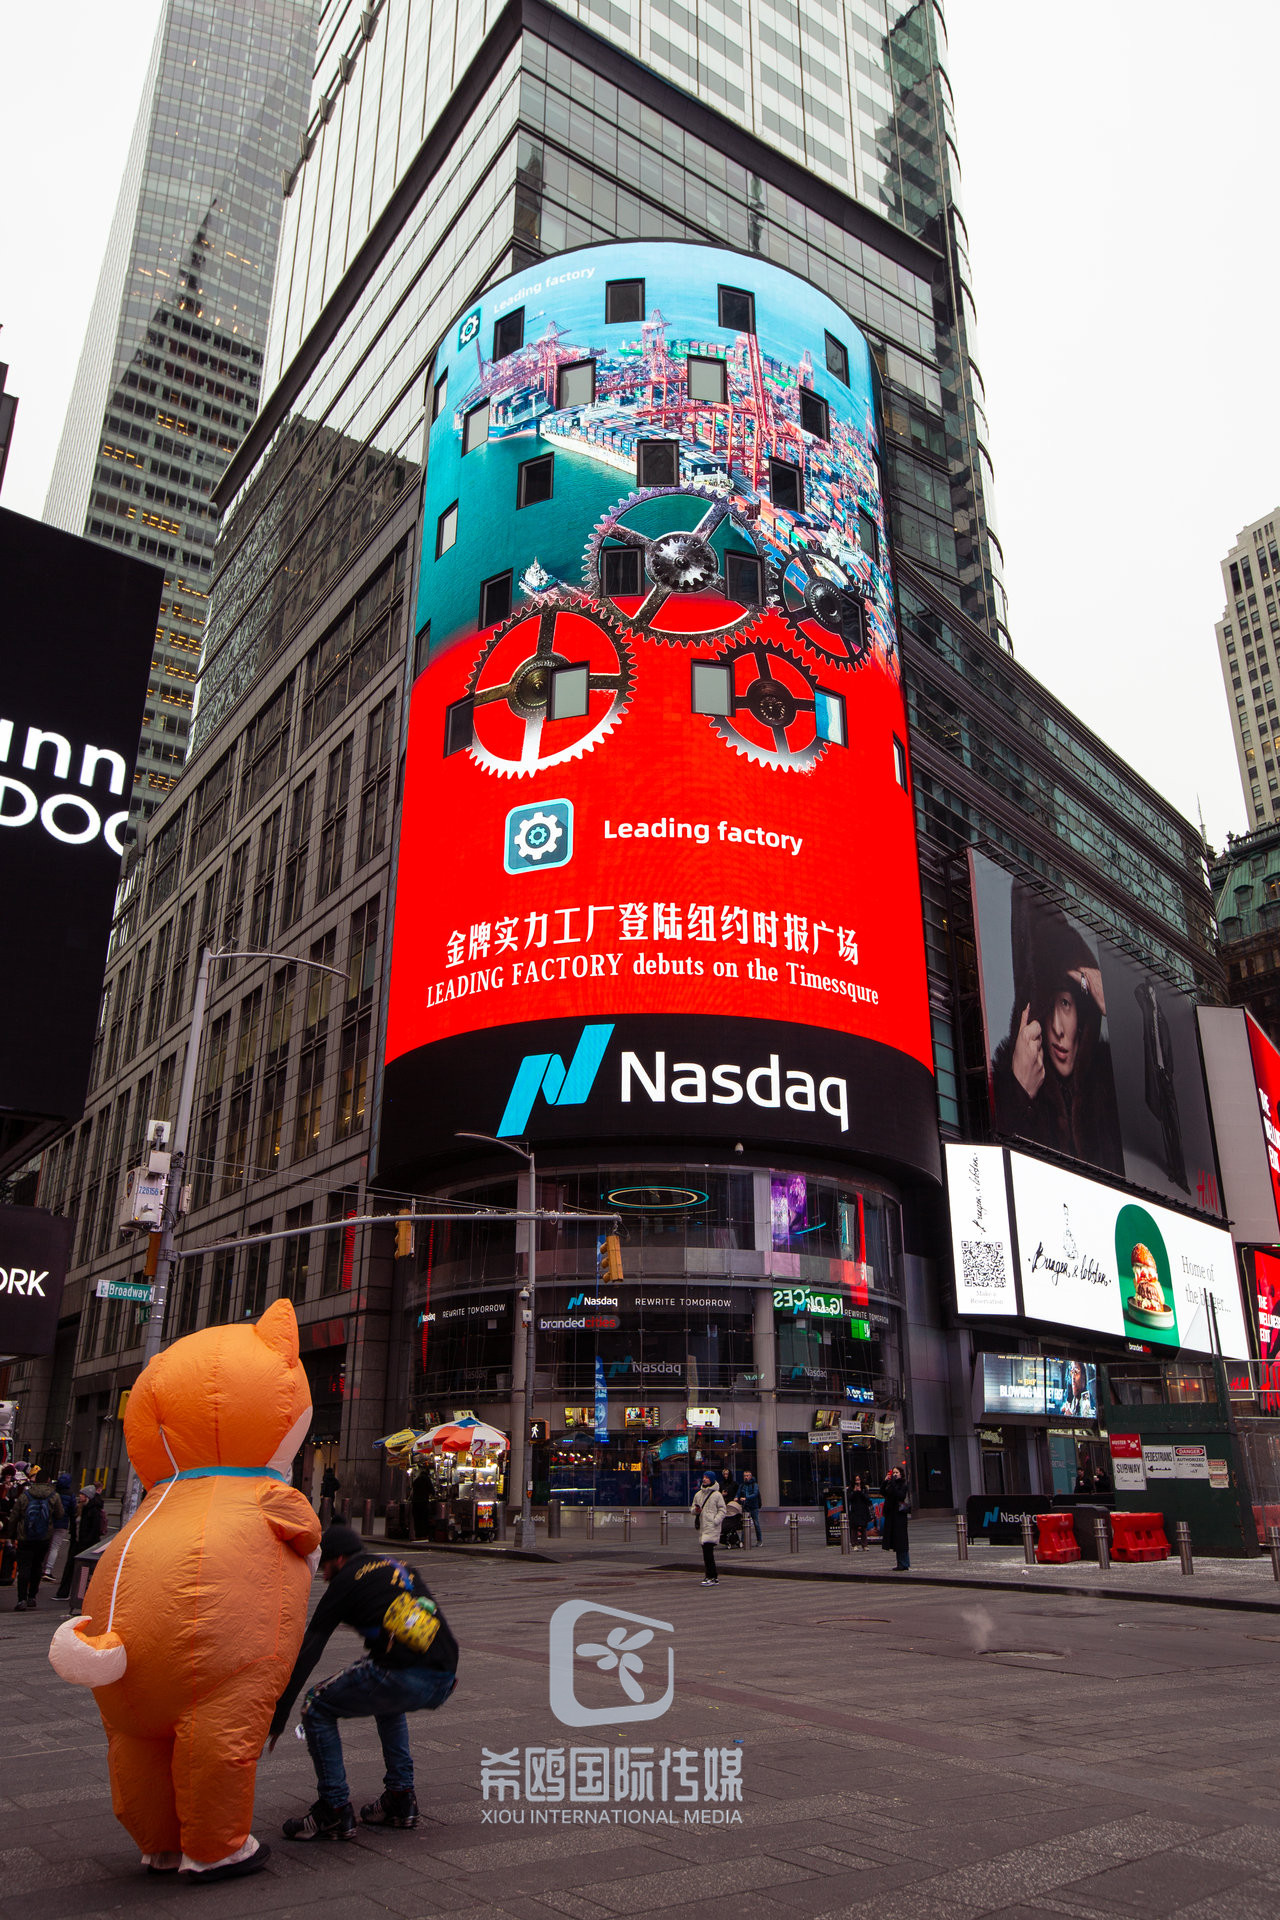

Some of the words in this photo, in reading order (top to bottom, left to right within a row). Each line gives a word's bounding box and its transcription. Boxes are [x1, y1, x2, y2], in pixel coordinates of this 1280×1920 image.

[493, 282, 542, 314] Leading
[545, 266, 596, 288] factory
[604, 817, 710, 844] Leading
[717, 820, 803, 856] factory
[445, 902, 859, 969] 金牌实力工厂登陆纽约时报广场
[426, 966, 504, 1008] LEADING
[511, 952, 624, 986] FACTORY
[633, 951, 704, 976] debuts
[712, 959, 739, 978] on
[747, 957, 779, 982] the
[786, 961, 879, 1005] Timessqure
[620, 1050, 849, 1133] Nasdaq
[1181, 1255, 1206, 1279] Home
[1206, 1264, 1215, 1282] of
[108, 1283, 149, 1301] Broadway
[1185, 1283, 1199, 1304] the
[584, 1296, 618, 1307] Nasdaq
[635, 1298, 676, 1306] REWRITE
[680, 1298, 732, 1307] TOMORROW
[442, 1306, 465, 1318] REWRITE
[467, 1303, 506, 1316] TOMORROW
[844, 1308, 867, 1320] REWRITE
[540, 1316, 616, 1329] brandedcities
[632, 1361, 681, 1377] Nasdaq
[804, 1367, 828, 1378] Nasdaq
[1144, 1451, 1172, 1462] PEDESTRIANS
[1116, 1463, 1141, 1474] SUBWAY
[1000, 1511, 1038, 1523] Nasda
